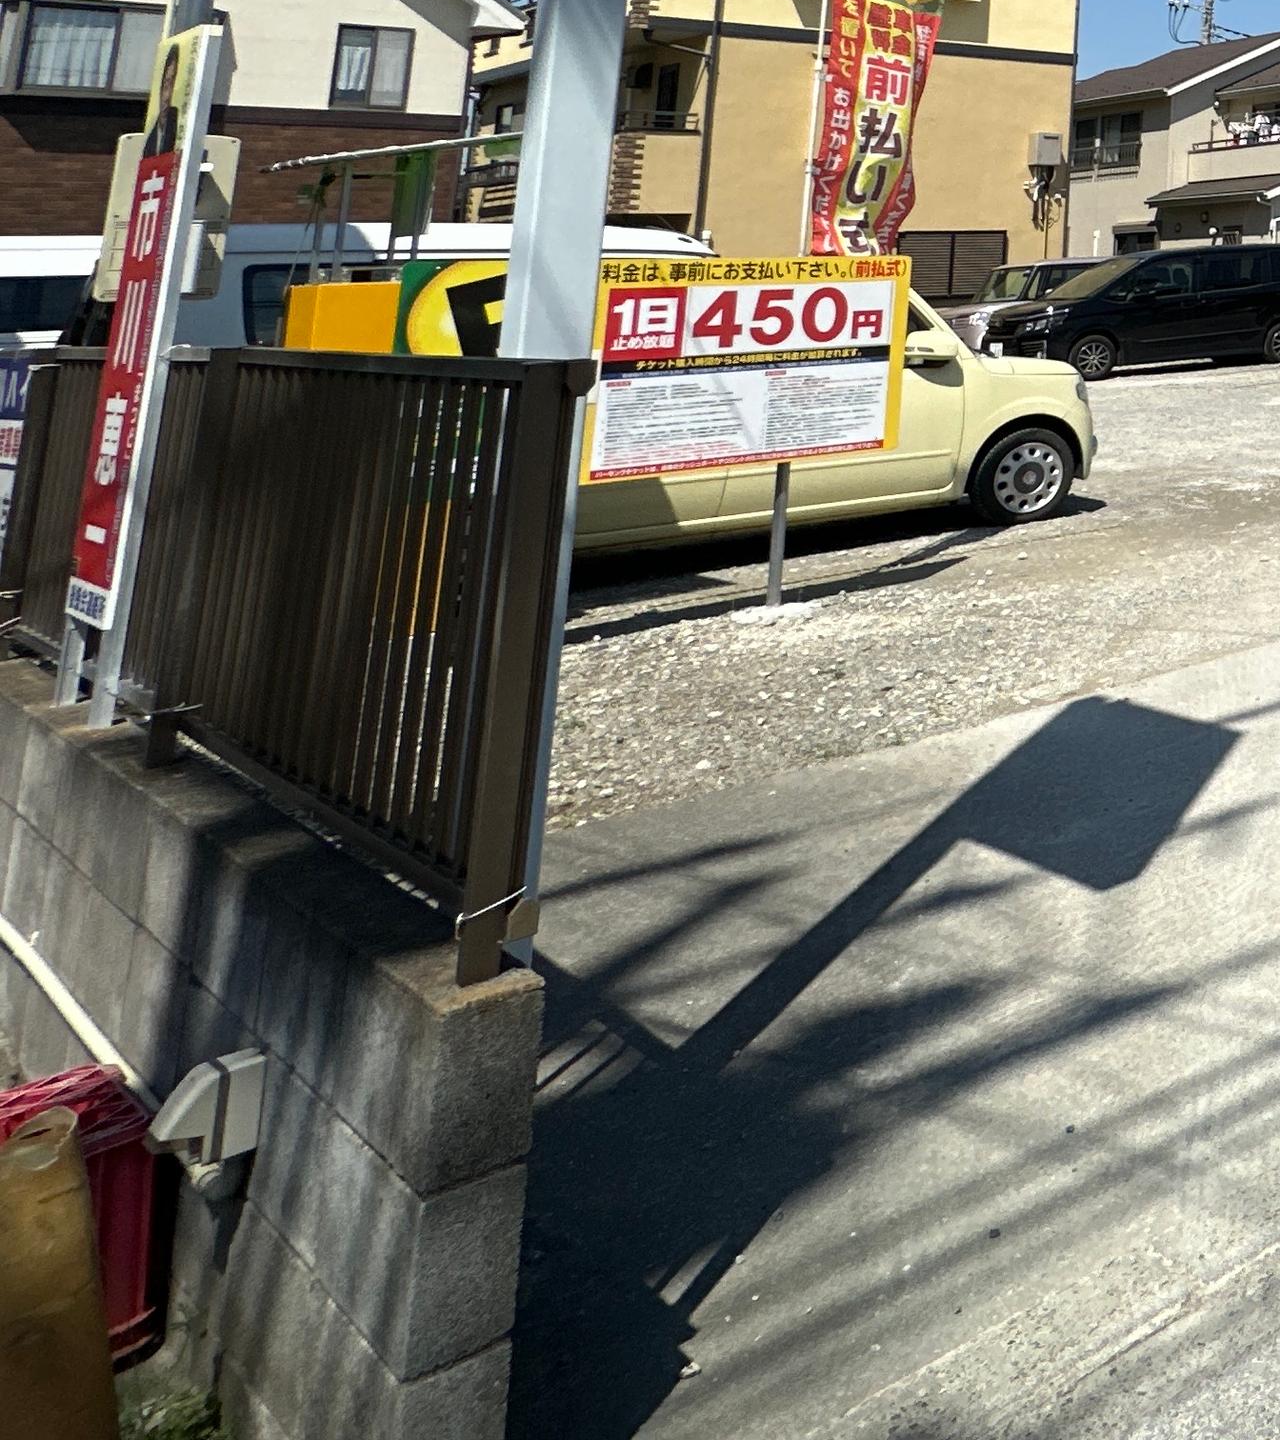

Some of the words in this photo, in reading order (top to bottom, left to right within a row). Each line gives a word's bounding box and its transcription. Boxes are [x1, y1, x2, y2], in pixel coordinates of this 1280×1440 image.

[612, 297, 679, 336] 1日
[691, 287, 884, 349] 450円
[610, 334, 676, 352] 止め放題
